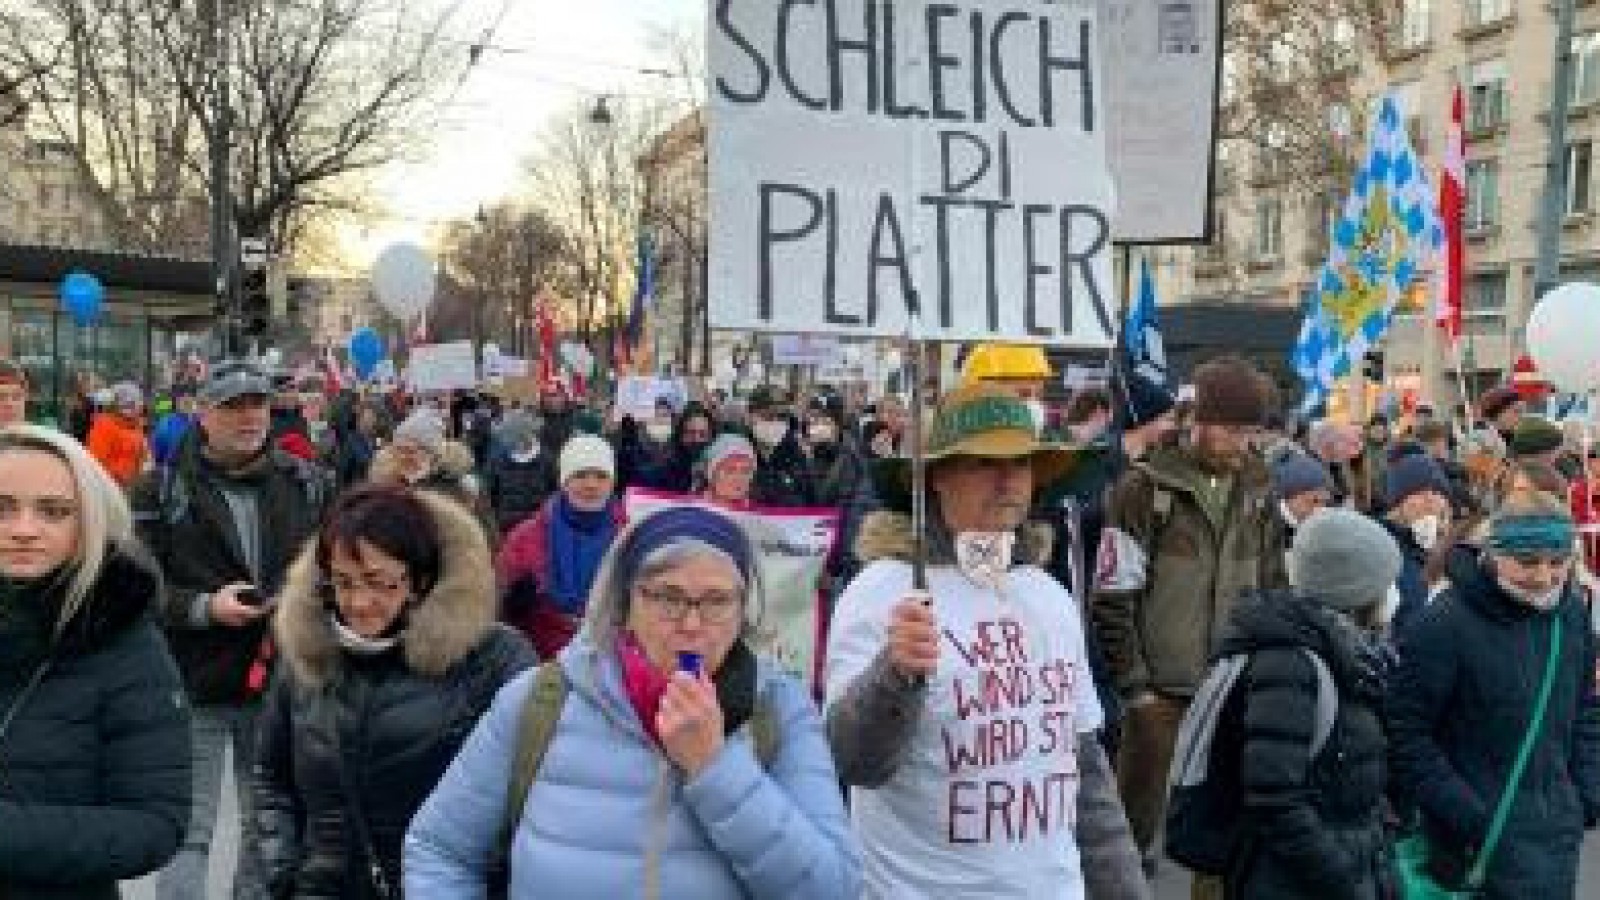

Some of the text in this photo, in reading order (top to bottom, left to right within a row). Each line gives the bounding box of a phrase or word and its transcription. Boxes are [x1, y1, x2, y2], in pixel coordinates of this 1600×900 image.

[715, 0, 1094, 132] SCHLEICH
[938, 130, 1012, 199] DI
[757, 183, 1118, 340] PLATTER
[942, 619, 1028, 669] WER
[953, 666, 1035, 721] WIND
[941, 716, 1028, 774] WIRD
